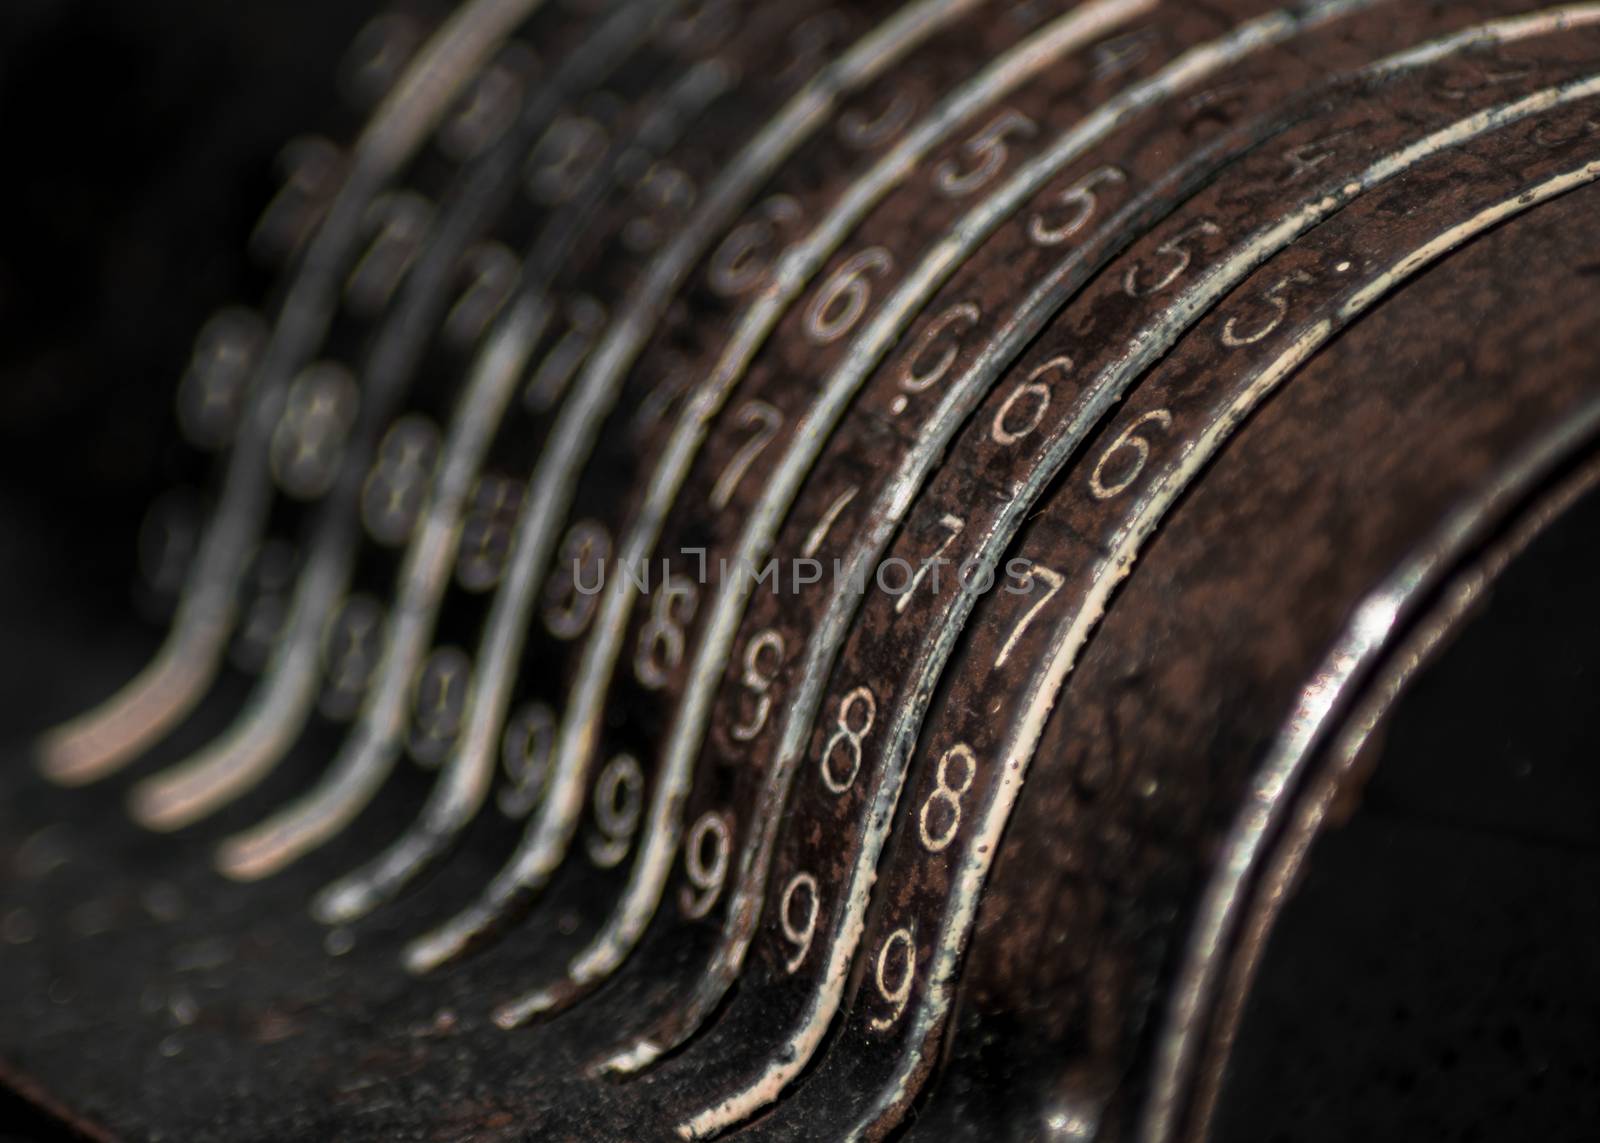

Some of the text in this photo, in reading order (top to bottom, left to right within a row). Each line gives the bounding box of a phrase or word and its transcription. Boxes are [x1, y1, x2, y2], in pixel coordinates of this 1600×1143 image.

[934, 107, 1038, 197] 5
[1028, 165, 1127, 246] 5
[803, 245, 894, 345] 6
[1124, 220, 1221, 296] 5
[1220, 270, 1315, 347] 5
[992, 355, 1074, 445] 6
[709, 399, 783, 511] 7
[1088, 408, 1173, 500] 6
[894, 513, 966, 614] 7
[633, 574, 701, 691] 8
[994, 564, 1066, 669] 7
[820, 685, 878, 793] 8
[584, 750, 646, 869] 9
[919, 741, 978, 853] 8
[677, 810, 731, 920] 9
[779, 871, 821, 975] 9
[869, 927, 918, 1031] 9
